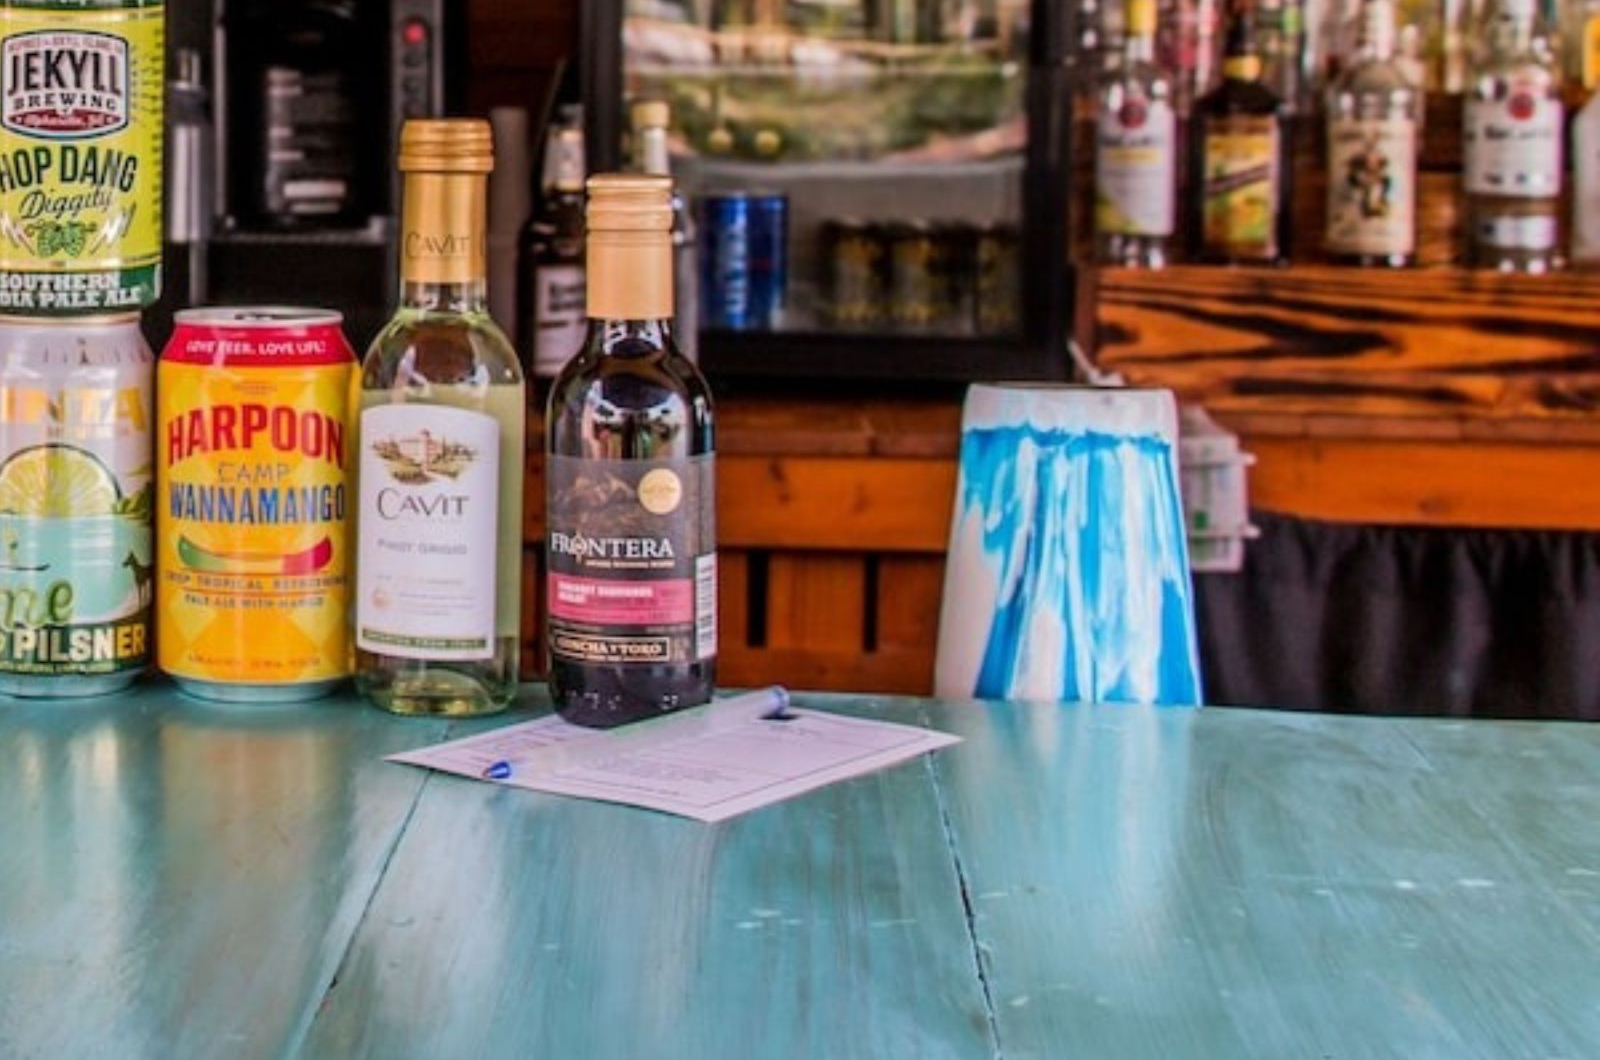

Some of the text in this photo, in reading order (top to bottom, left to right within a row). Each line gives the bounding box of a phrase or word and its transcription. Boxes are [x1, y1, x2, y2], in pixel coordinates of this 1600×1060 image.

[7, 49, 122, 96] JEKYLL
[13, 92, 118, 111] BREWING
[59, 145, 139, 192] DANG
[18, 188, 115, 221] Diggity
[406, 232, 470, 258] CAVIT
[39, 290, 101, 308] PALE
[103, 287, 143, 306] ALE
[258, 342, 295, 355] LOVE
[167, 404, 345, 471] HARPOON
[219, 462, 290, 483] CAMP
[169, 481, 345, 525] WANNAMANGO
[376, 487, 470, 521] CAVIT
[551, 531, 675, 562] FRONTERA
[12, 623, 146, 664] PILSNER
